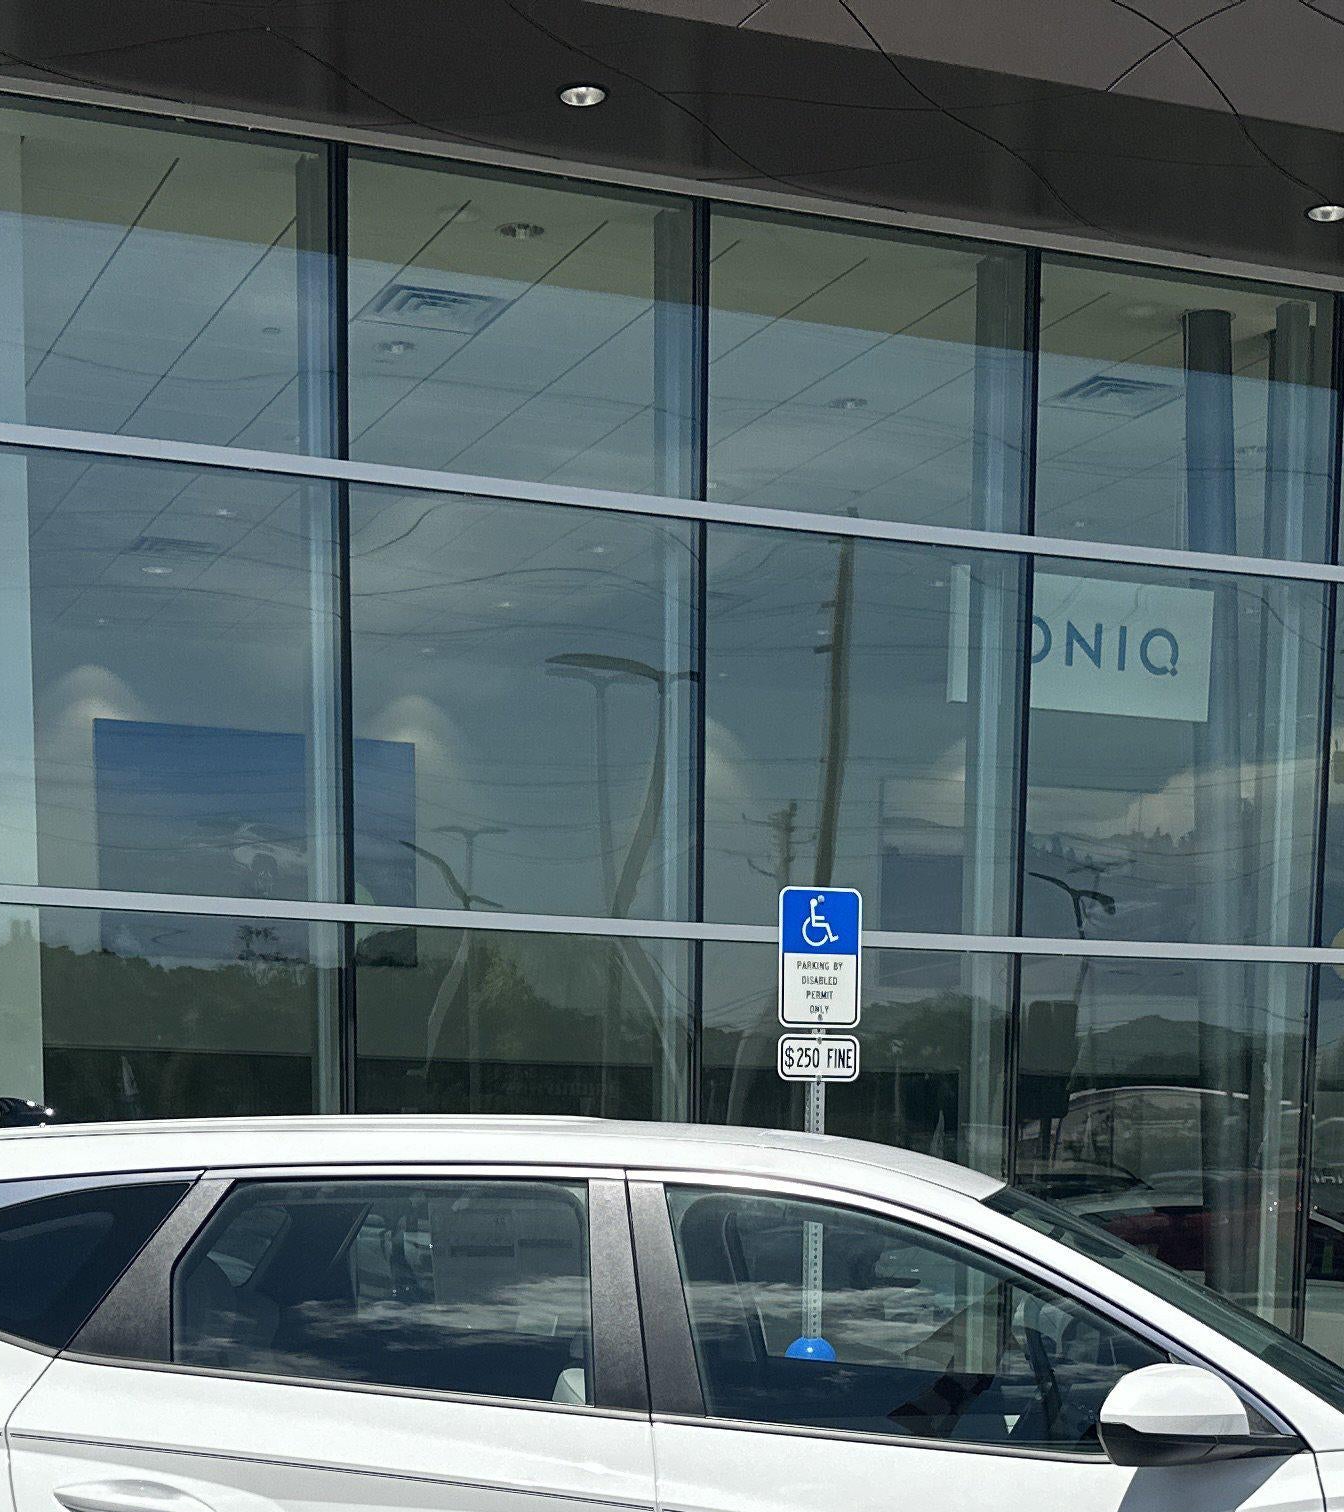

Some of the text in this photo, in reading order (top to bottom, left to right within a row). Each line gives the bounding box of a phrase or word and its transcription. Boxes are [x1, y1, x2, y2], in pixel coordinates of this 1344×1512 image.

[796, 960, 844, 971] PARKING BY
[801, 976, 838, 985] DISABLED
[806, 990, 834, 1000] PERMIT
[809, 1004, 829, 1014] ONLY
[785, 1046, 853, 1069] $250 FINE
